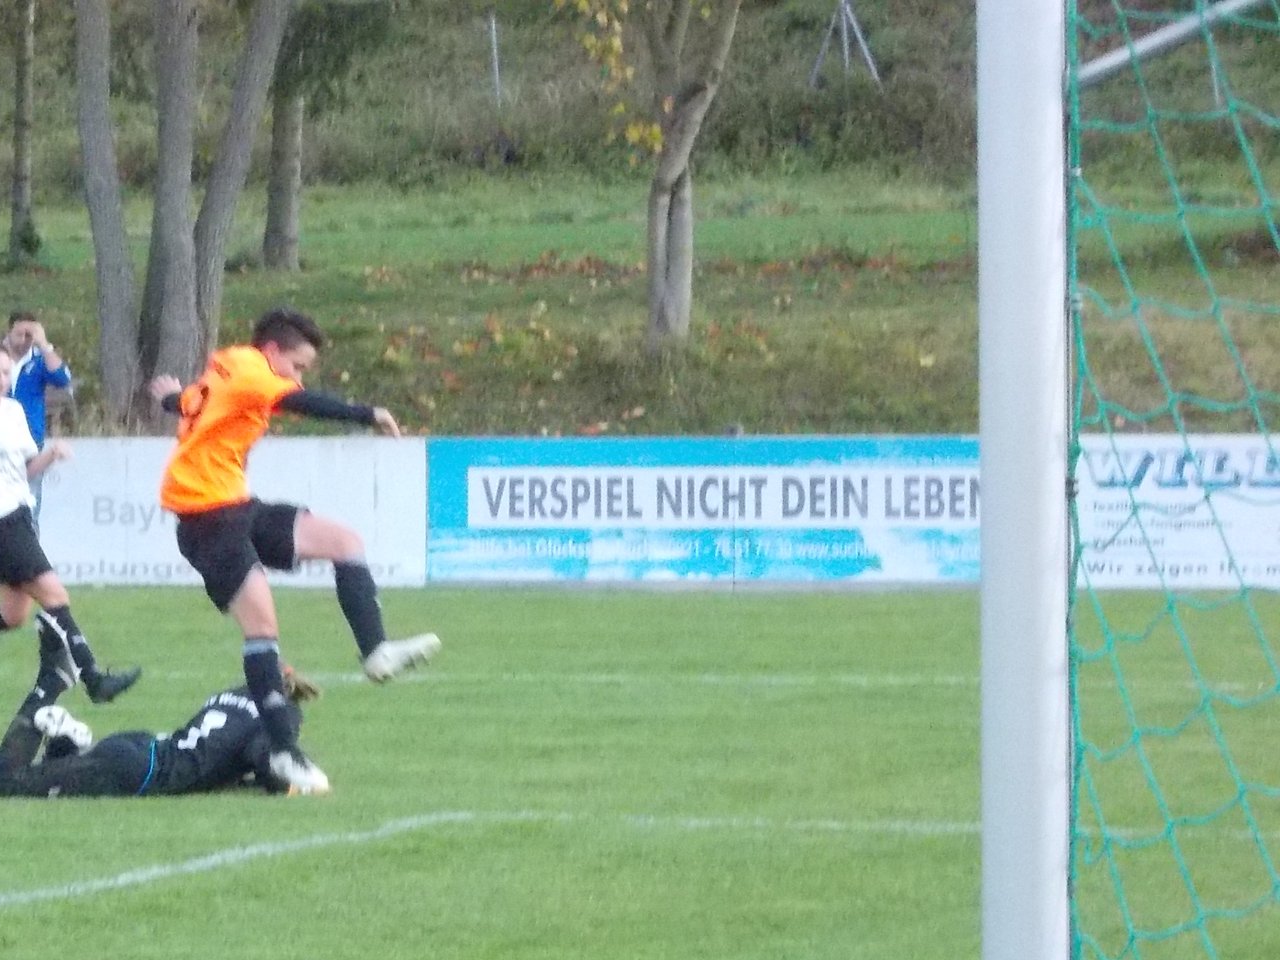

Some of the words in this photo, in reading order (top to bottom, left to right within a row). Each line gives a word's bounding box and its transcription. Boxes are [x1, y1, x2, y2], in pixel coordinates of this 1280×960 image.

[482, 474, 643, 520] VERSPIEL
[656, 474, 768, 520] NICHT
[781, 474, 869, 520] DEIN
